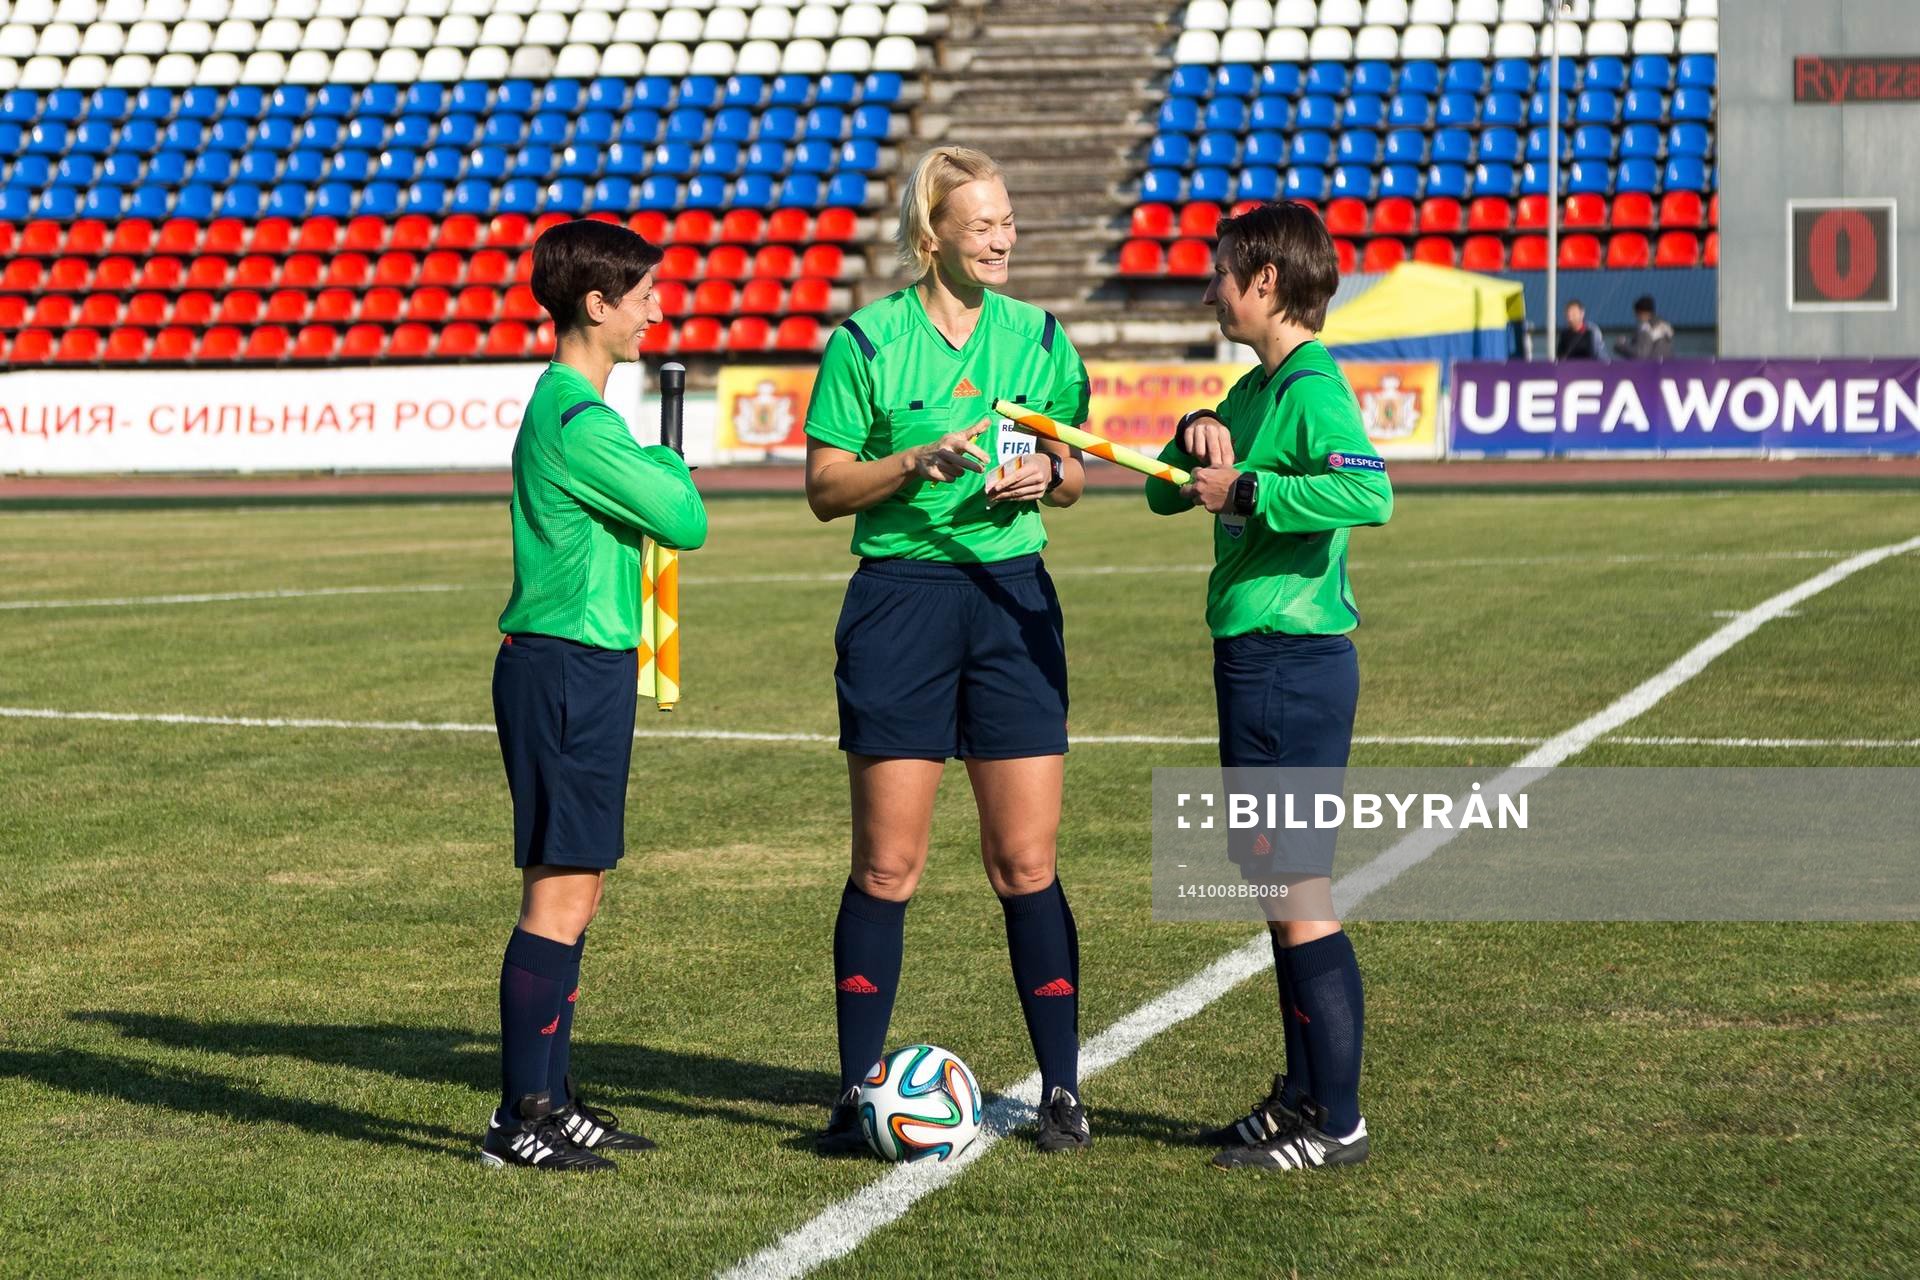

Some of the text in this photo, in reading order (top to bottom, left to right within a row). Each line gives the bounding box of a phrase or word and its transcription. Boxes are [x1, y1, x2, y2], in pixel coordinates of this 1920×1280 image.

[1808, 208, 1877, 300] 0
[149, 402, 375, 434] СИЛЬНАЯ
[393, 399, 520, 432] РОСС
[1460, 377, 1920, 434] UEFA WOMEN
[1002, 442, 1031, 454] FIFA
[1344, 457, 1385, 470] RESPECT
